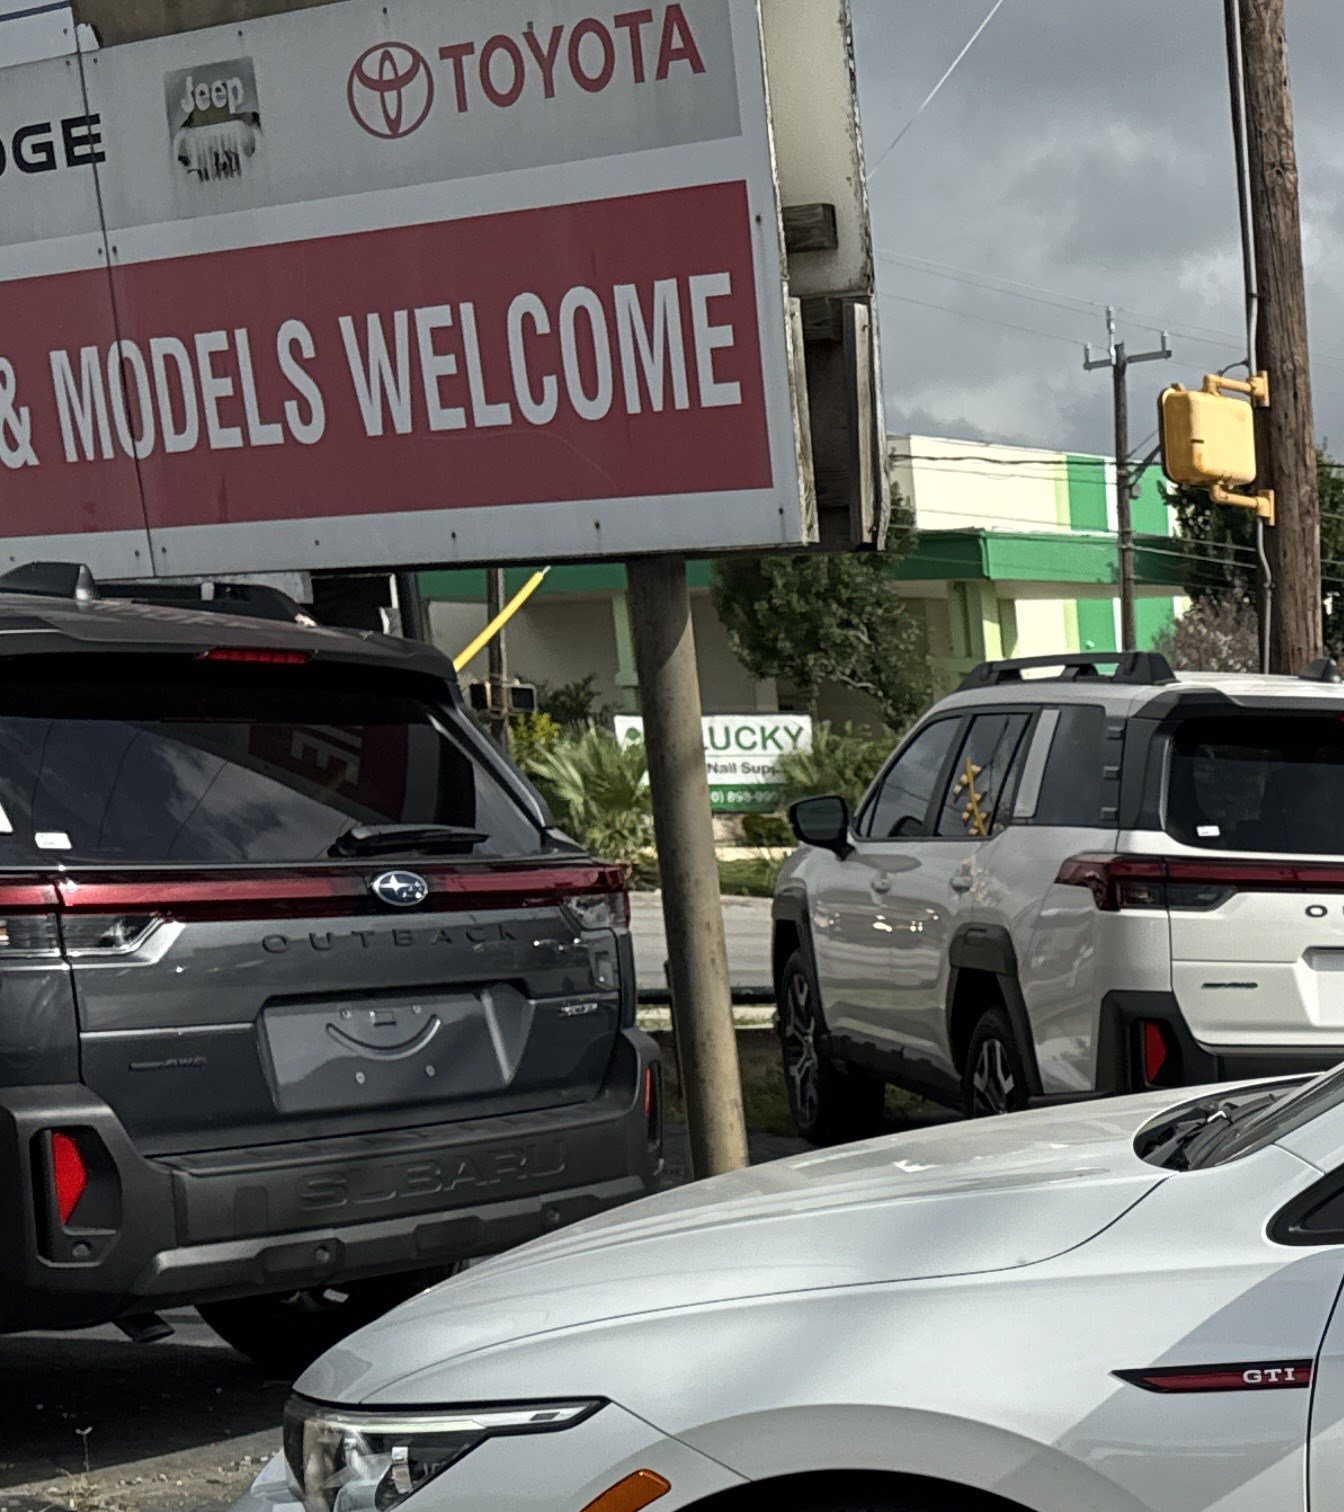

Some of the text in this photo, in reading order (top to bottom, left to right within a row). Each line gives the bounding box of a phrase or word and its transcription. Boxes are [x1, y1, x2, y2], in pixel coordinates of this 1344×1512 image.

[438, 3, 707, 113] TOYOTA
[180, 75, 244, 115] Jeep
[0, 113, 106, 178] GE
[0, 272, 742, 469] & MODELS WELCOME
[703, 725, 803, 751] UCKY
[261, 923, 516, 955] OUTBACK
[302, 1138, 565, 1213] SUBARU
[1242, 1367, 1296, 1384] GTI
